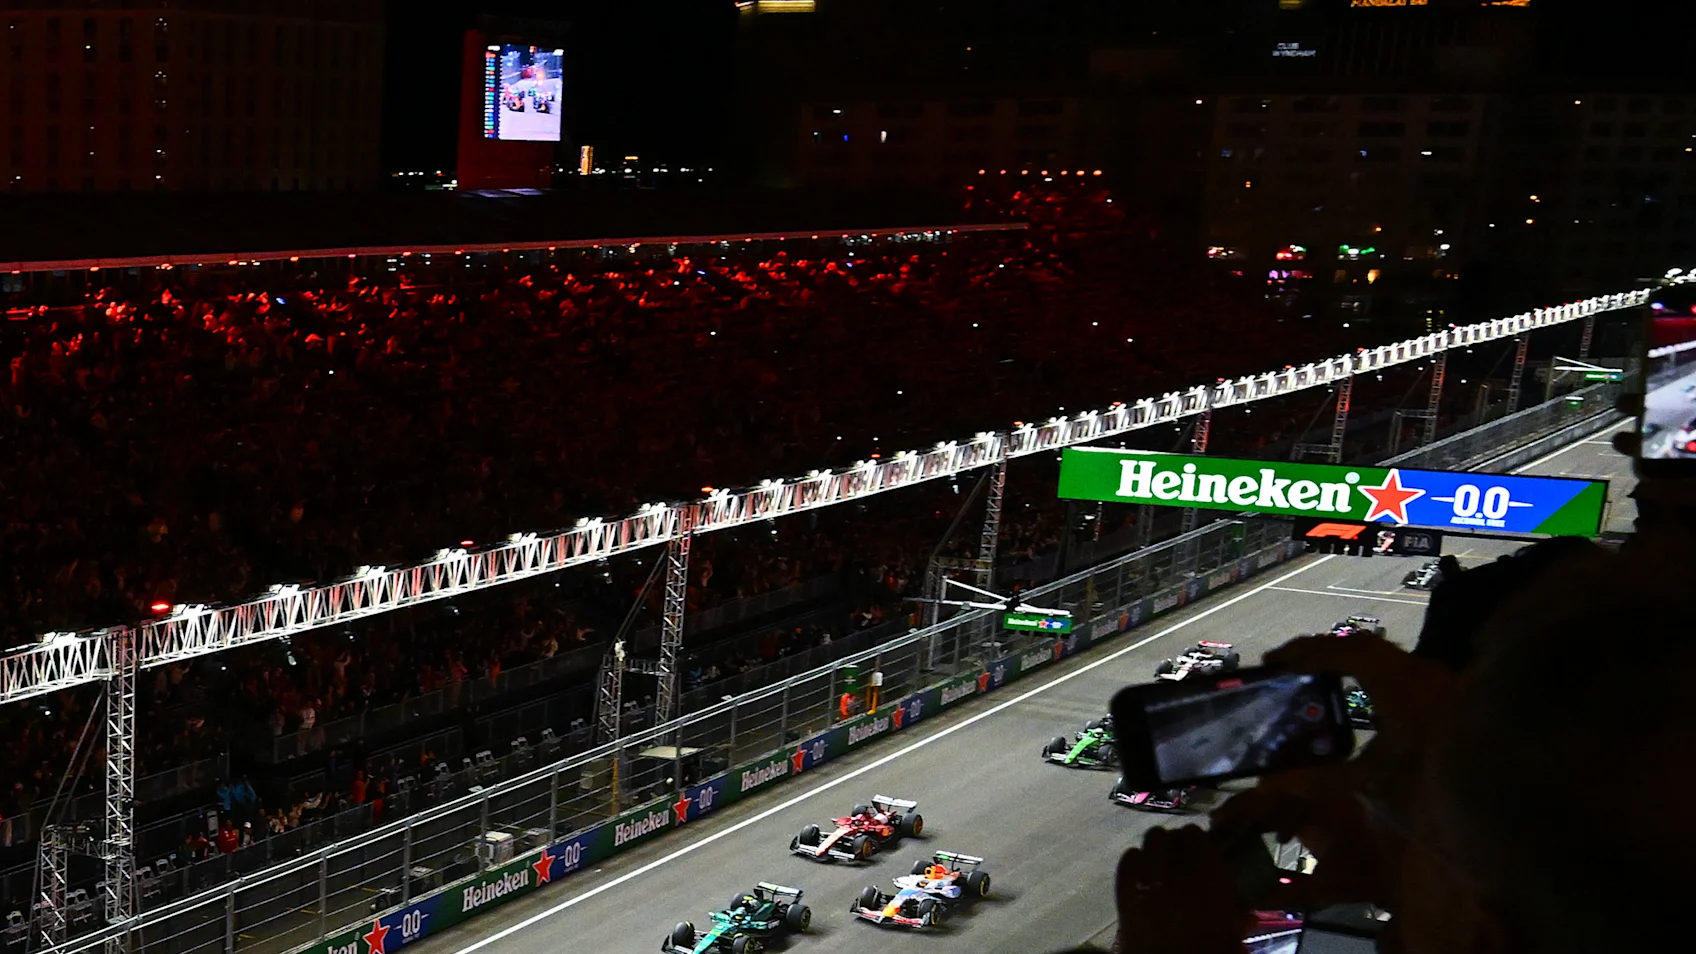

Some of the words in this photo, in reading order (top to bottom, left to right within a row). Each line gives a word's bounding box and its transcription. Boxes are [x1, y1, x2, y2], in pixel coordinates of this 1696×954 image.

[1116, 459, 1351, 513] Heineken
[1453, 484, 1510, 519] 0.0
[1404, 536, 1430, 549] FIA
[848, 716, 889, 745] Heineken
[741, 759, 788, 792] Heineken
[614, 809, 670, 846] Heineken
[462, 868, 528, 912] Heineken
